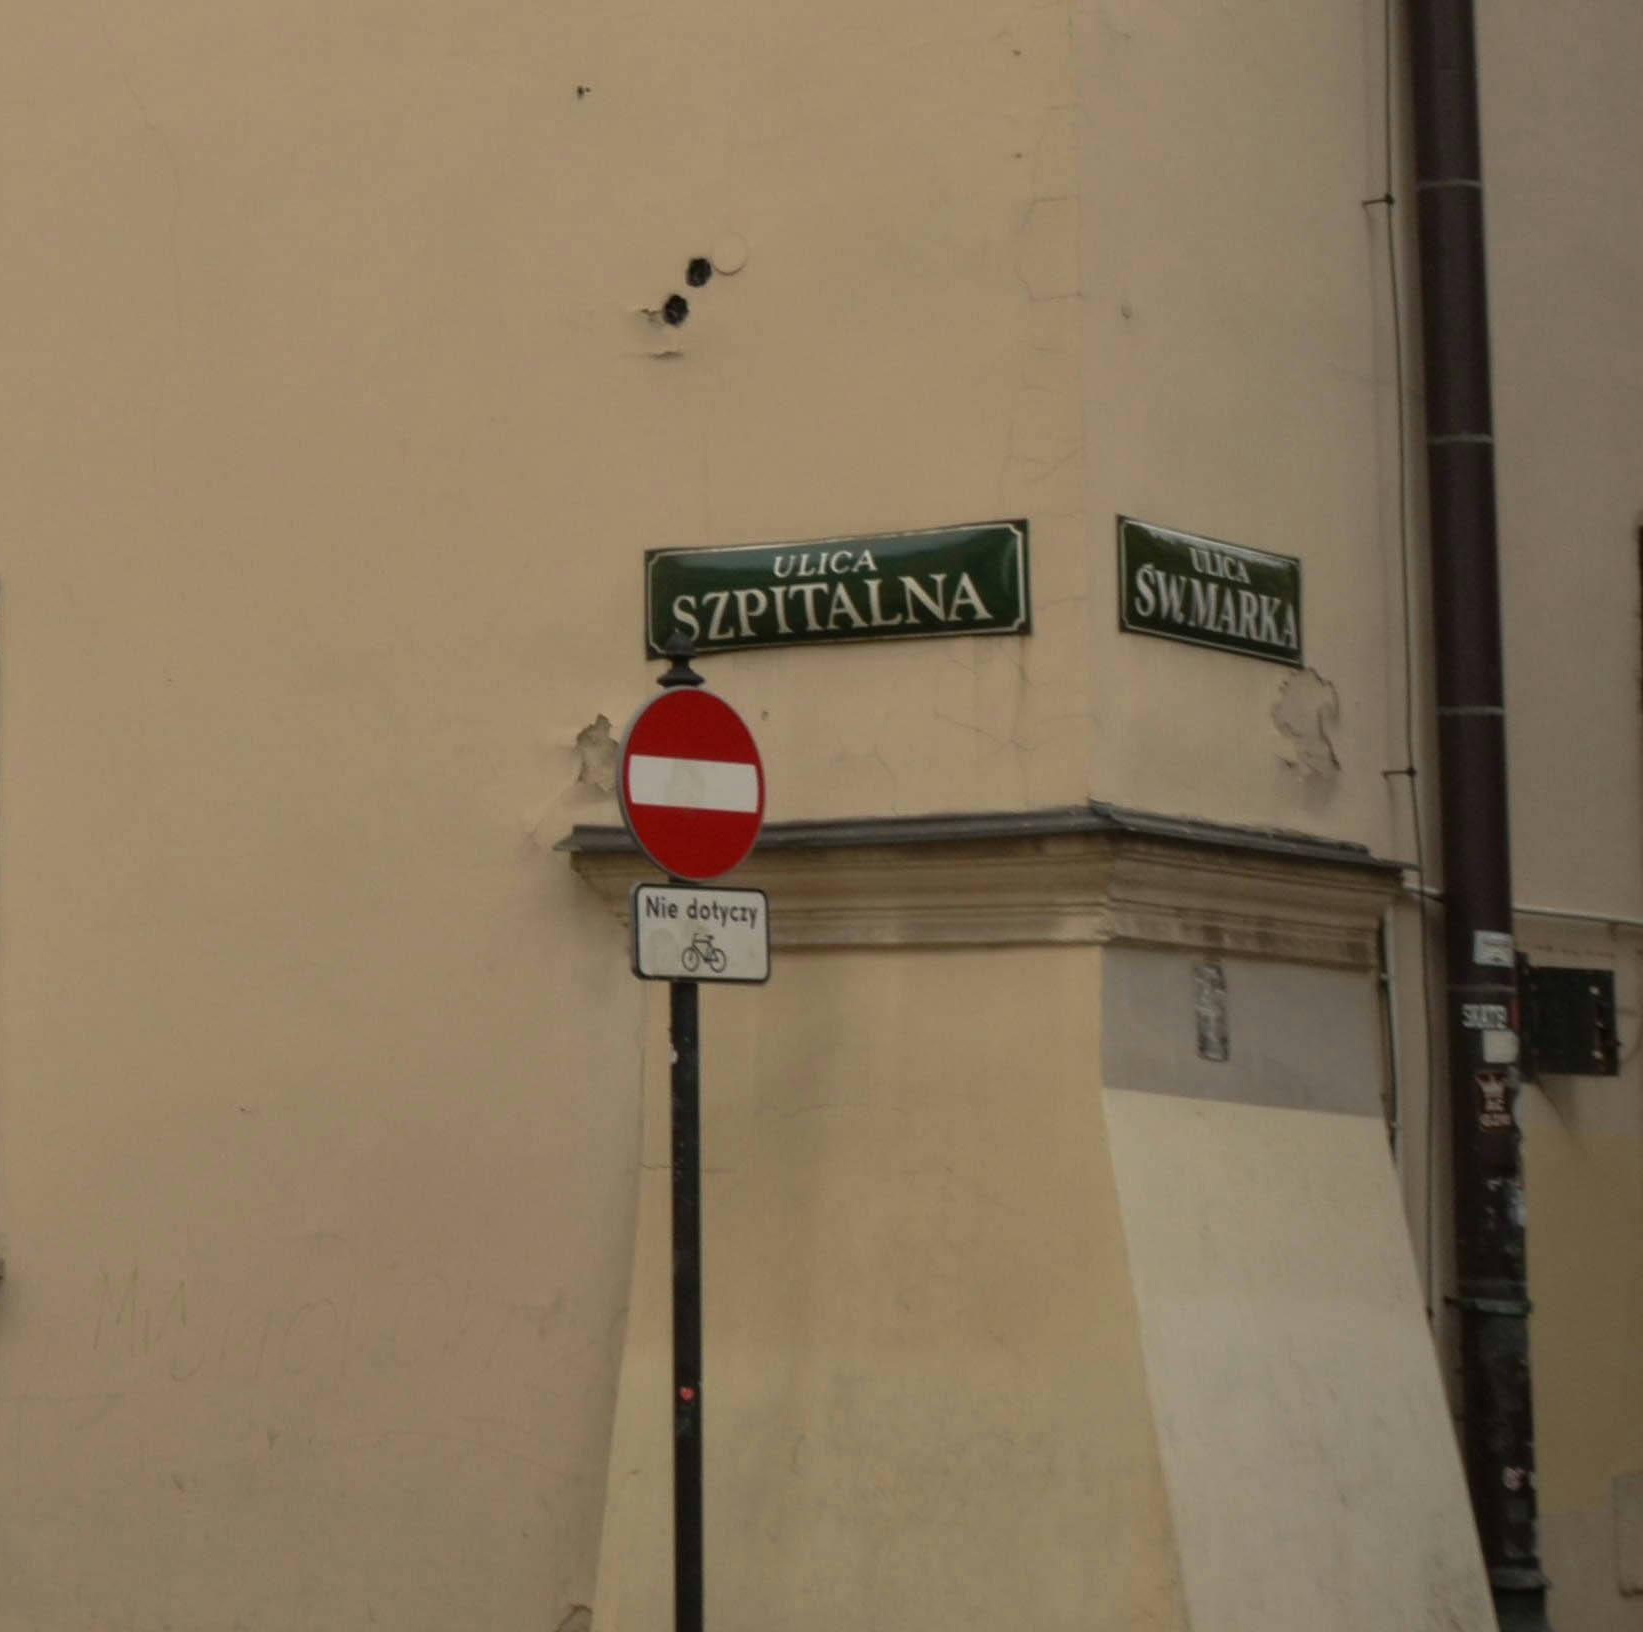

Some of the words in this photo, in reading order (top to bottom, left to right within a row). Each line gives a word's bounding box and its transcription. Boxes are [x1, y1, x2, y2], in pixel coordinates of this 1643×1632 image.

[773, 549, 877, 579] ULICA
[1189, 546, 1251, 584] ULICA
[672, 571, 992, 641] SZPITALNA
[645, 895, 678, 919] Nie
[686, 897, 757, 930] dotyczy
